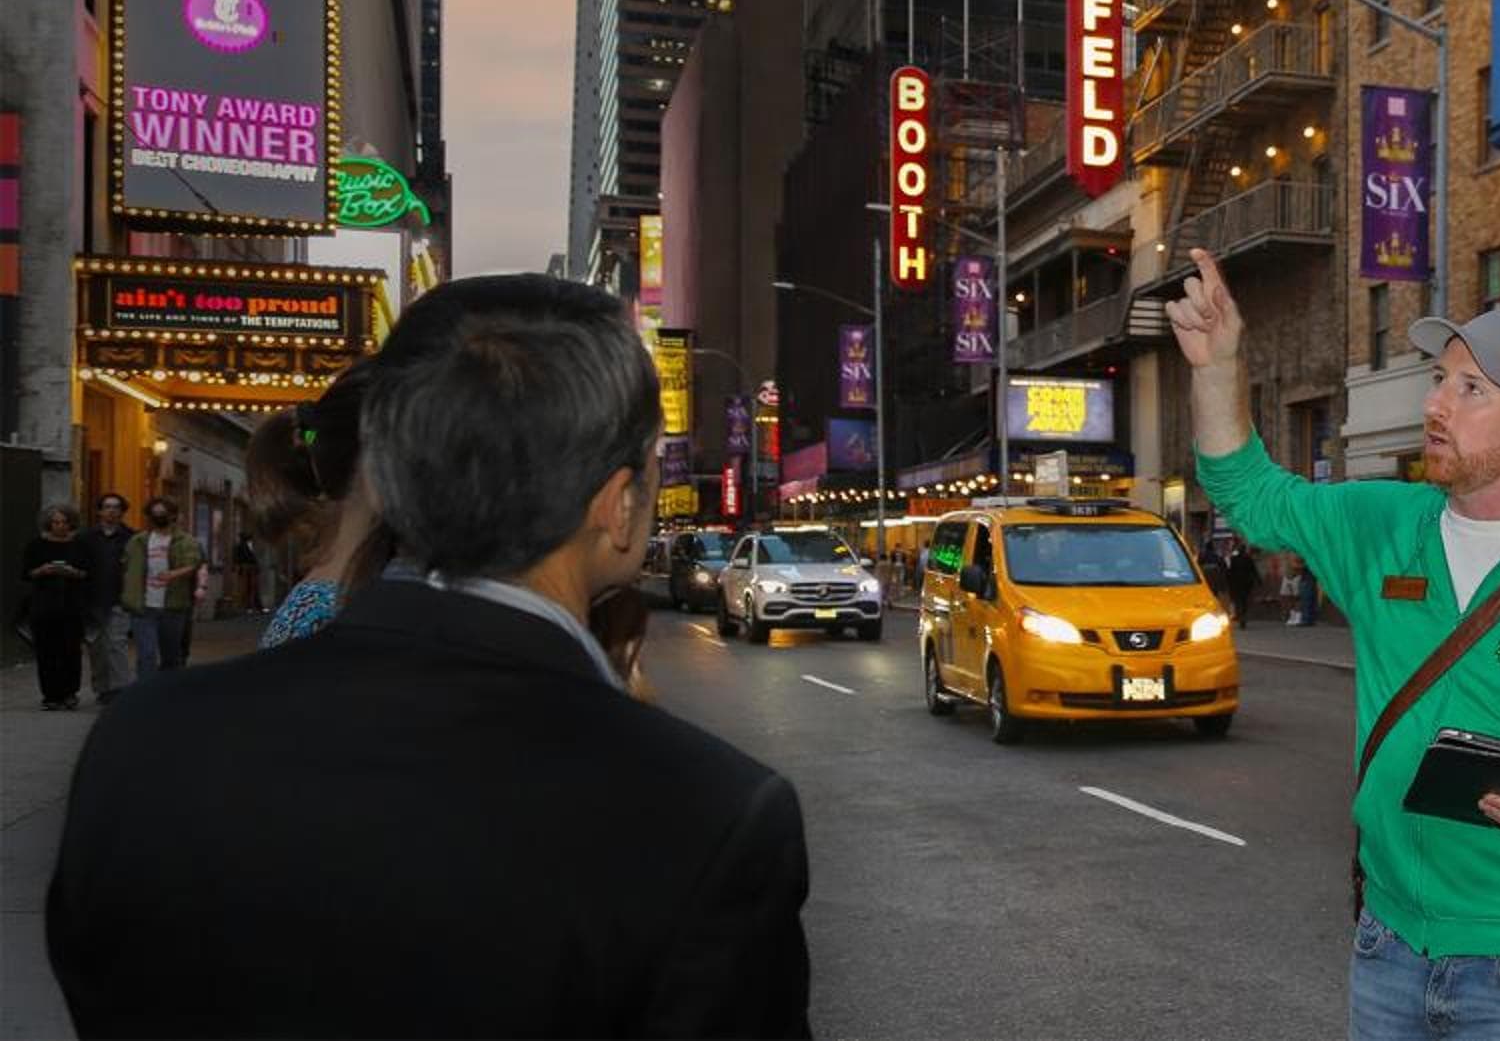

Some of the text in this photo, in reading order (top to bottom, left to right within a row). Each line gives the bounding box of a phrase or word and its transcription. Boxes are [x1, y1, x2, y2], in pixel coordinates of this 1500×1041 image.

[132, 86, 319, 127] TONY AWARD
[131, 110, 319, 166] WINNER
[131, 148, 319, 182] BEST CHOREOGRAPHY
[897, 75, 927, 281] BOOTH
[339, 191, 402, 218] Box
[114, 287, 338, 316] ain't too proud
[240, 315, 261, 327] THE
[263, 315, 340, 330] TEMPTATIONS
